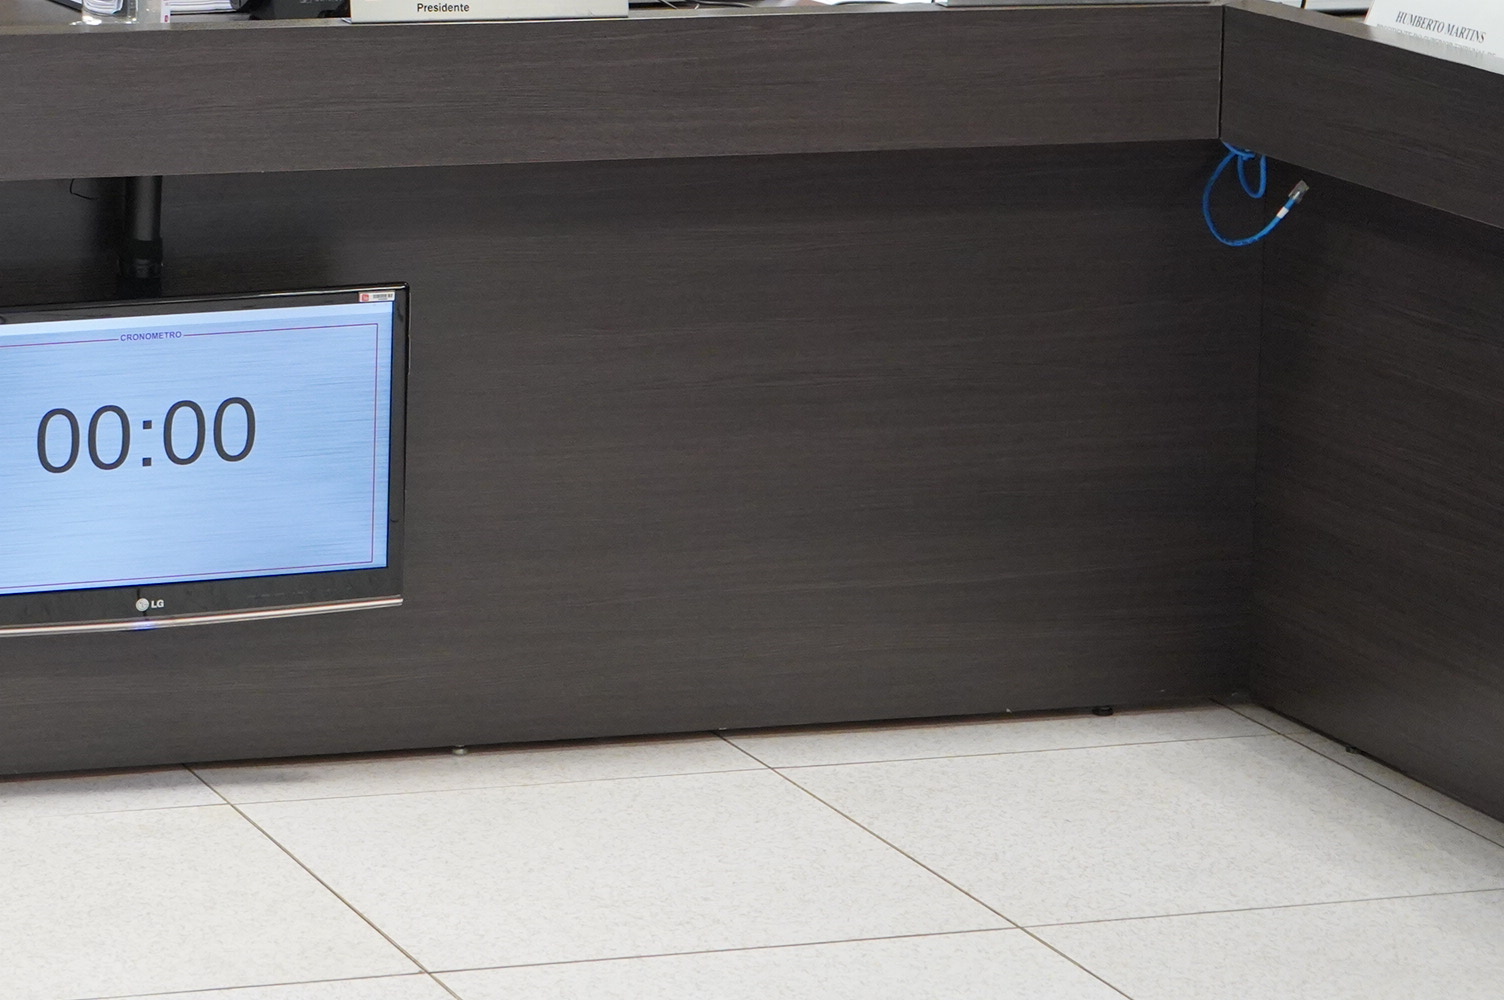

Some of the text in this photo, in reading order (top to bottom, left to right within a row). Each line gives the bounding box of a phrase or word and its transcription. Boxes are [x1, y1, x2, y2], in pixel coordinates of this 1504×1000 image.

[417, 3, 470, 12] Presidente
[1395, 11, 1445, 34] HUMBERTO
[1445, 22, 1487, 44] MARTINS
[120, 331, 182, 341] CRONOMETRO
[37, 397, 256, 474] 00:00
[151, 599, 164, 609] LG
